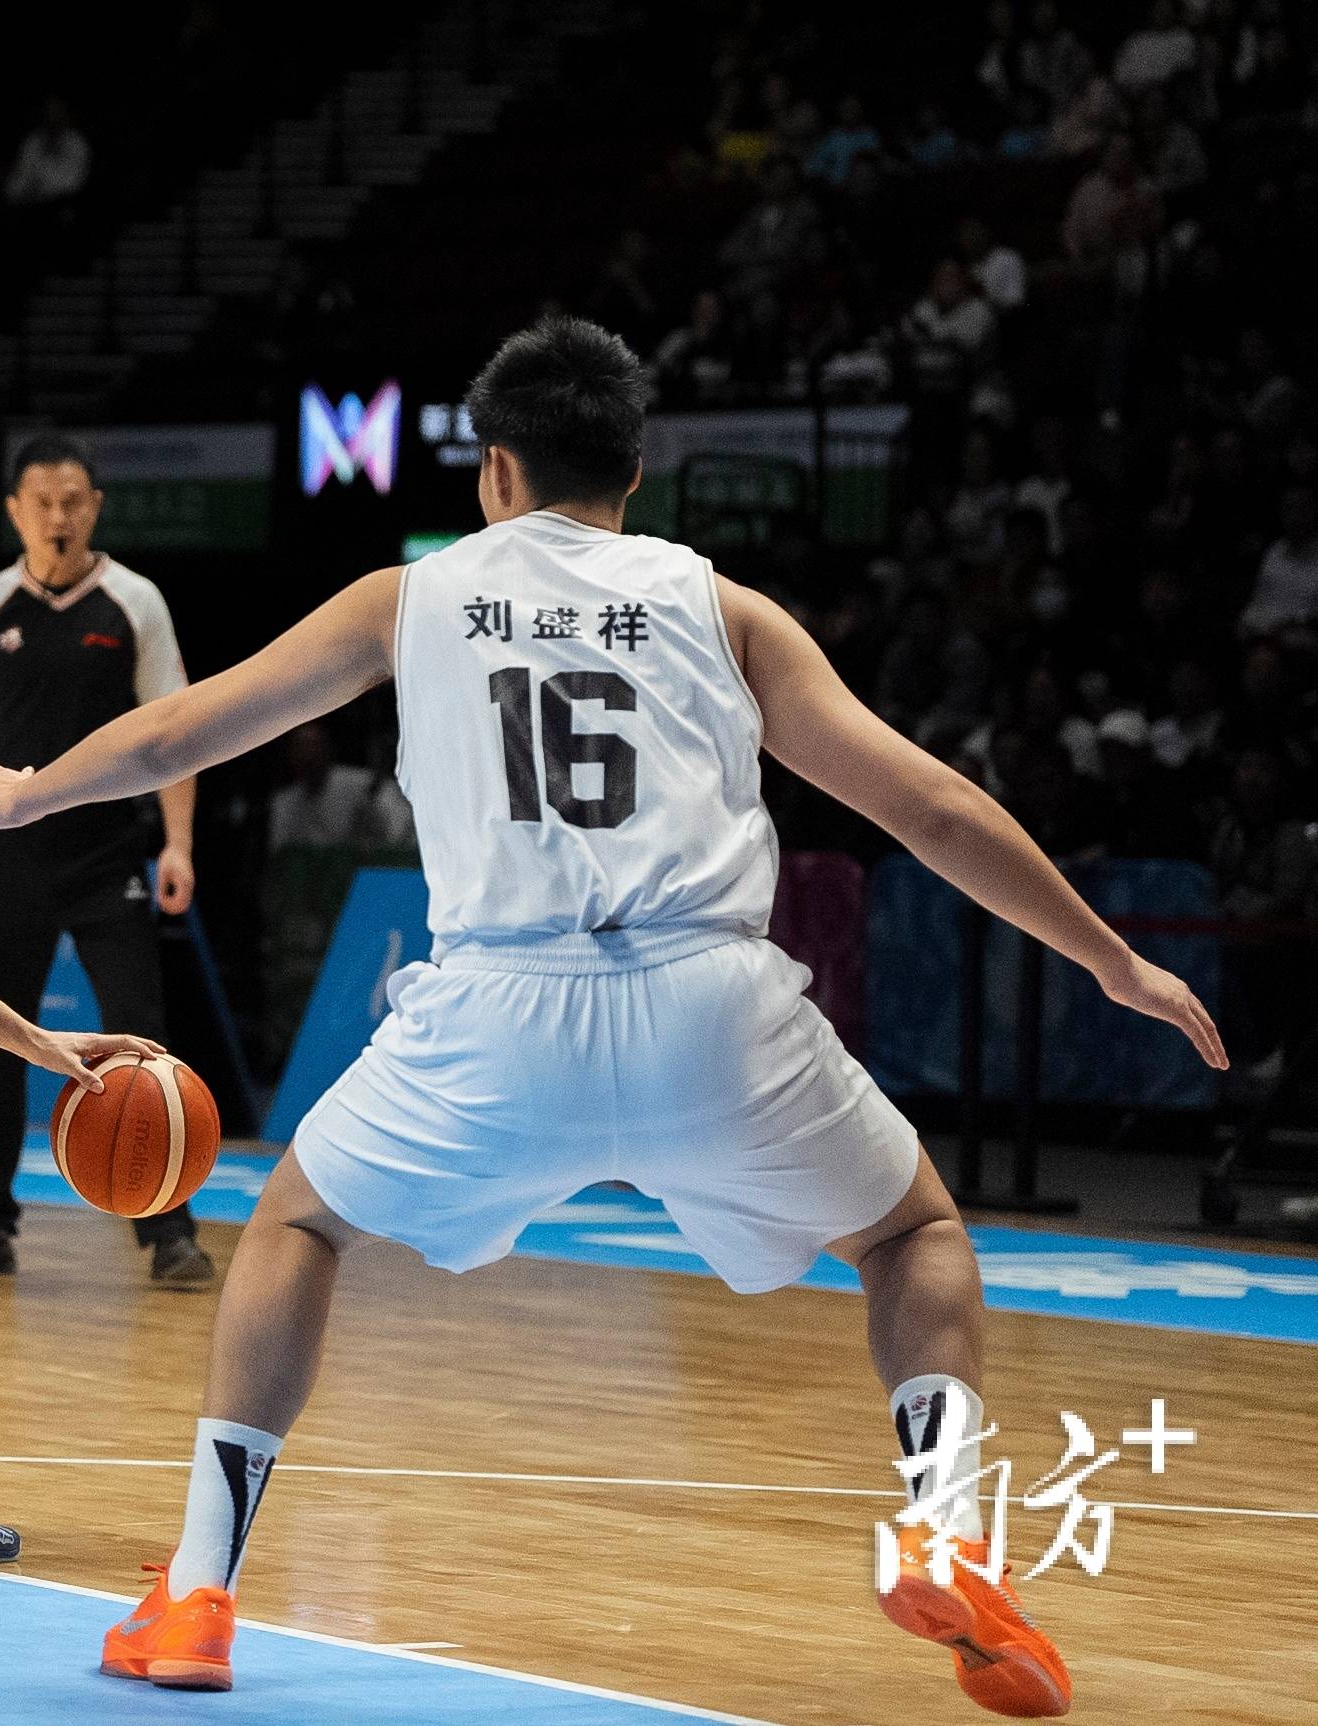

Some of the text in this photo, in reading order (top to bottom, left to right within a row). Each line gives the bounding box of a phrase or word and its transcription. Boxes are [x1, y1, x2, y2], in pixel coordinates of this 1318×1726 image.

[463, 596, 650, 652] 刘盛祥
[488, 667, 637, 829] 16
[126, 1120, 149, 1191] molten
